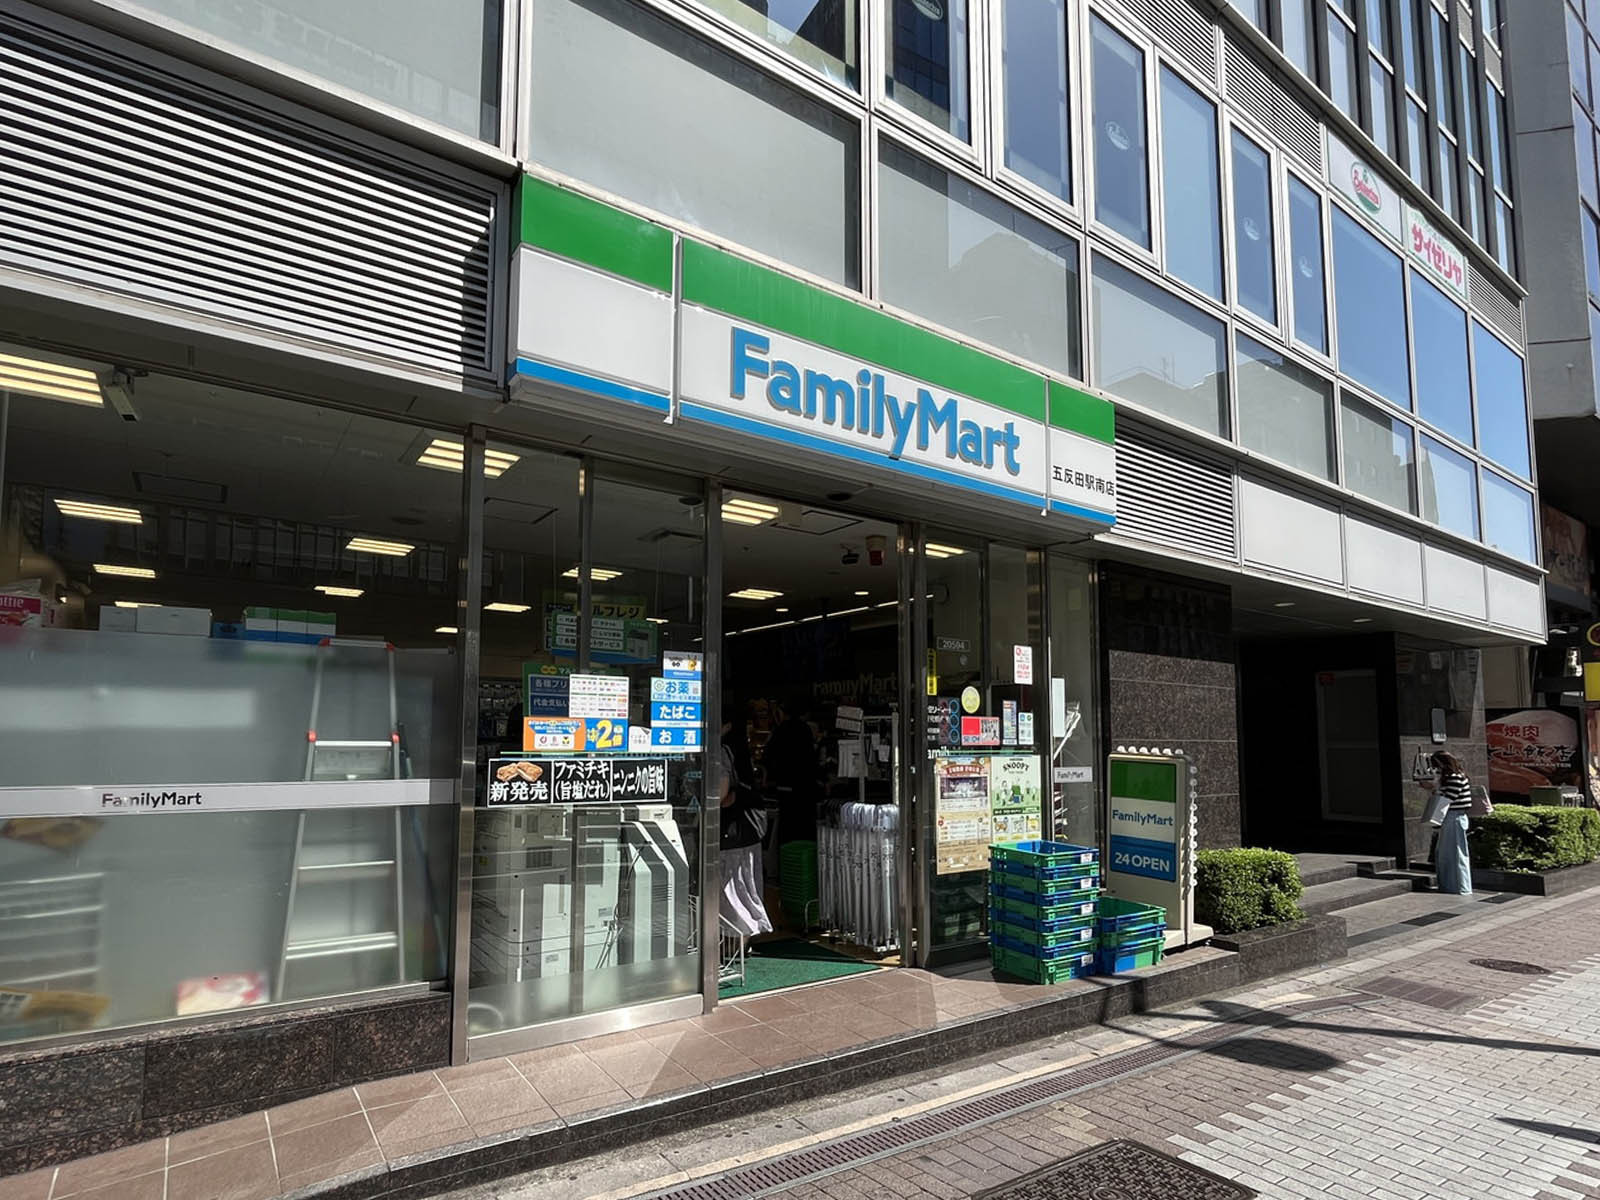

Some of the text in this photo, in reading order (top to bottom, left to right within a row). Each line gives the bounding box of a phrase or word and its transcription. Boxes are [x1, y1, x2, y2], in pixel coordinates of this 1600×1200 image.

[1411, 223, 1462, 287] サイゼリヤ
[729, 326, 1021, 477] FamilyMart
[1052, 465, 1115, 497] 五反田駅南店
[943, 640, 965, 649] 20594
[665, 681, 689, 694] お薬
[659, 704, 697, 719] たばこ
[1504, 725, 1540, 738] 焼肉
[555, 760, 610, 779] ファミチキ
[612, 765, 665, 795] ニンニクの旨味
[489, 781, 549, 802] 新発売
[1112, 809, 1174, 828] FamilyMart
[1114, 851, 1171, 873] 24 OPEN
